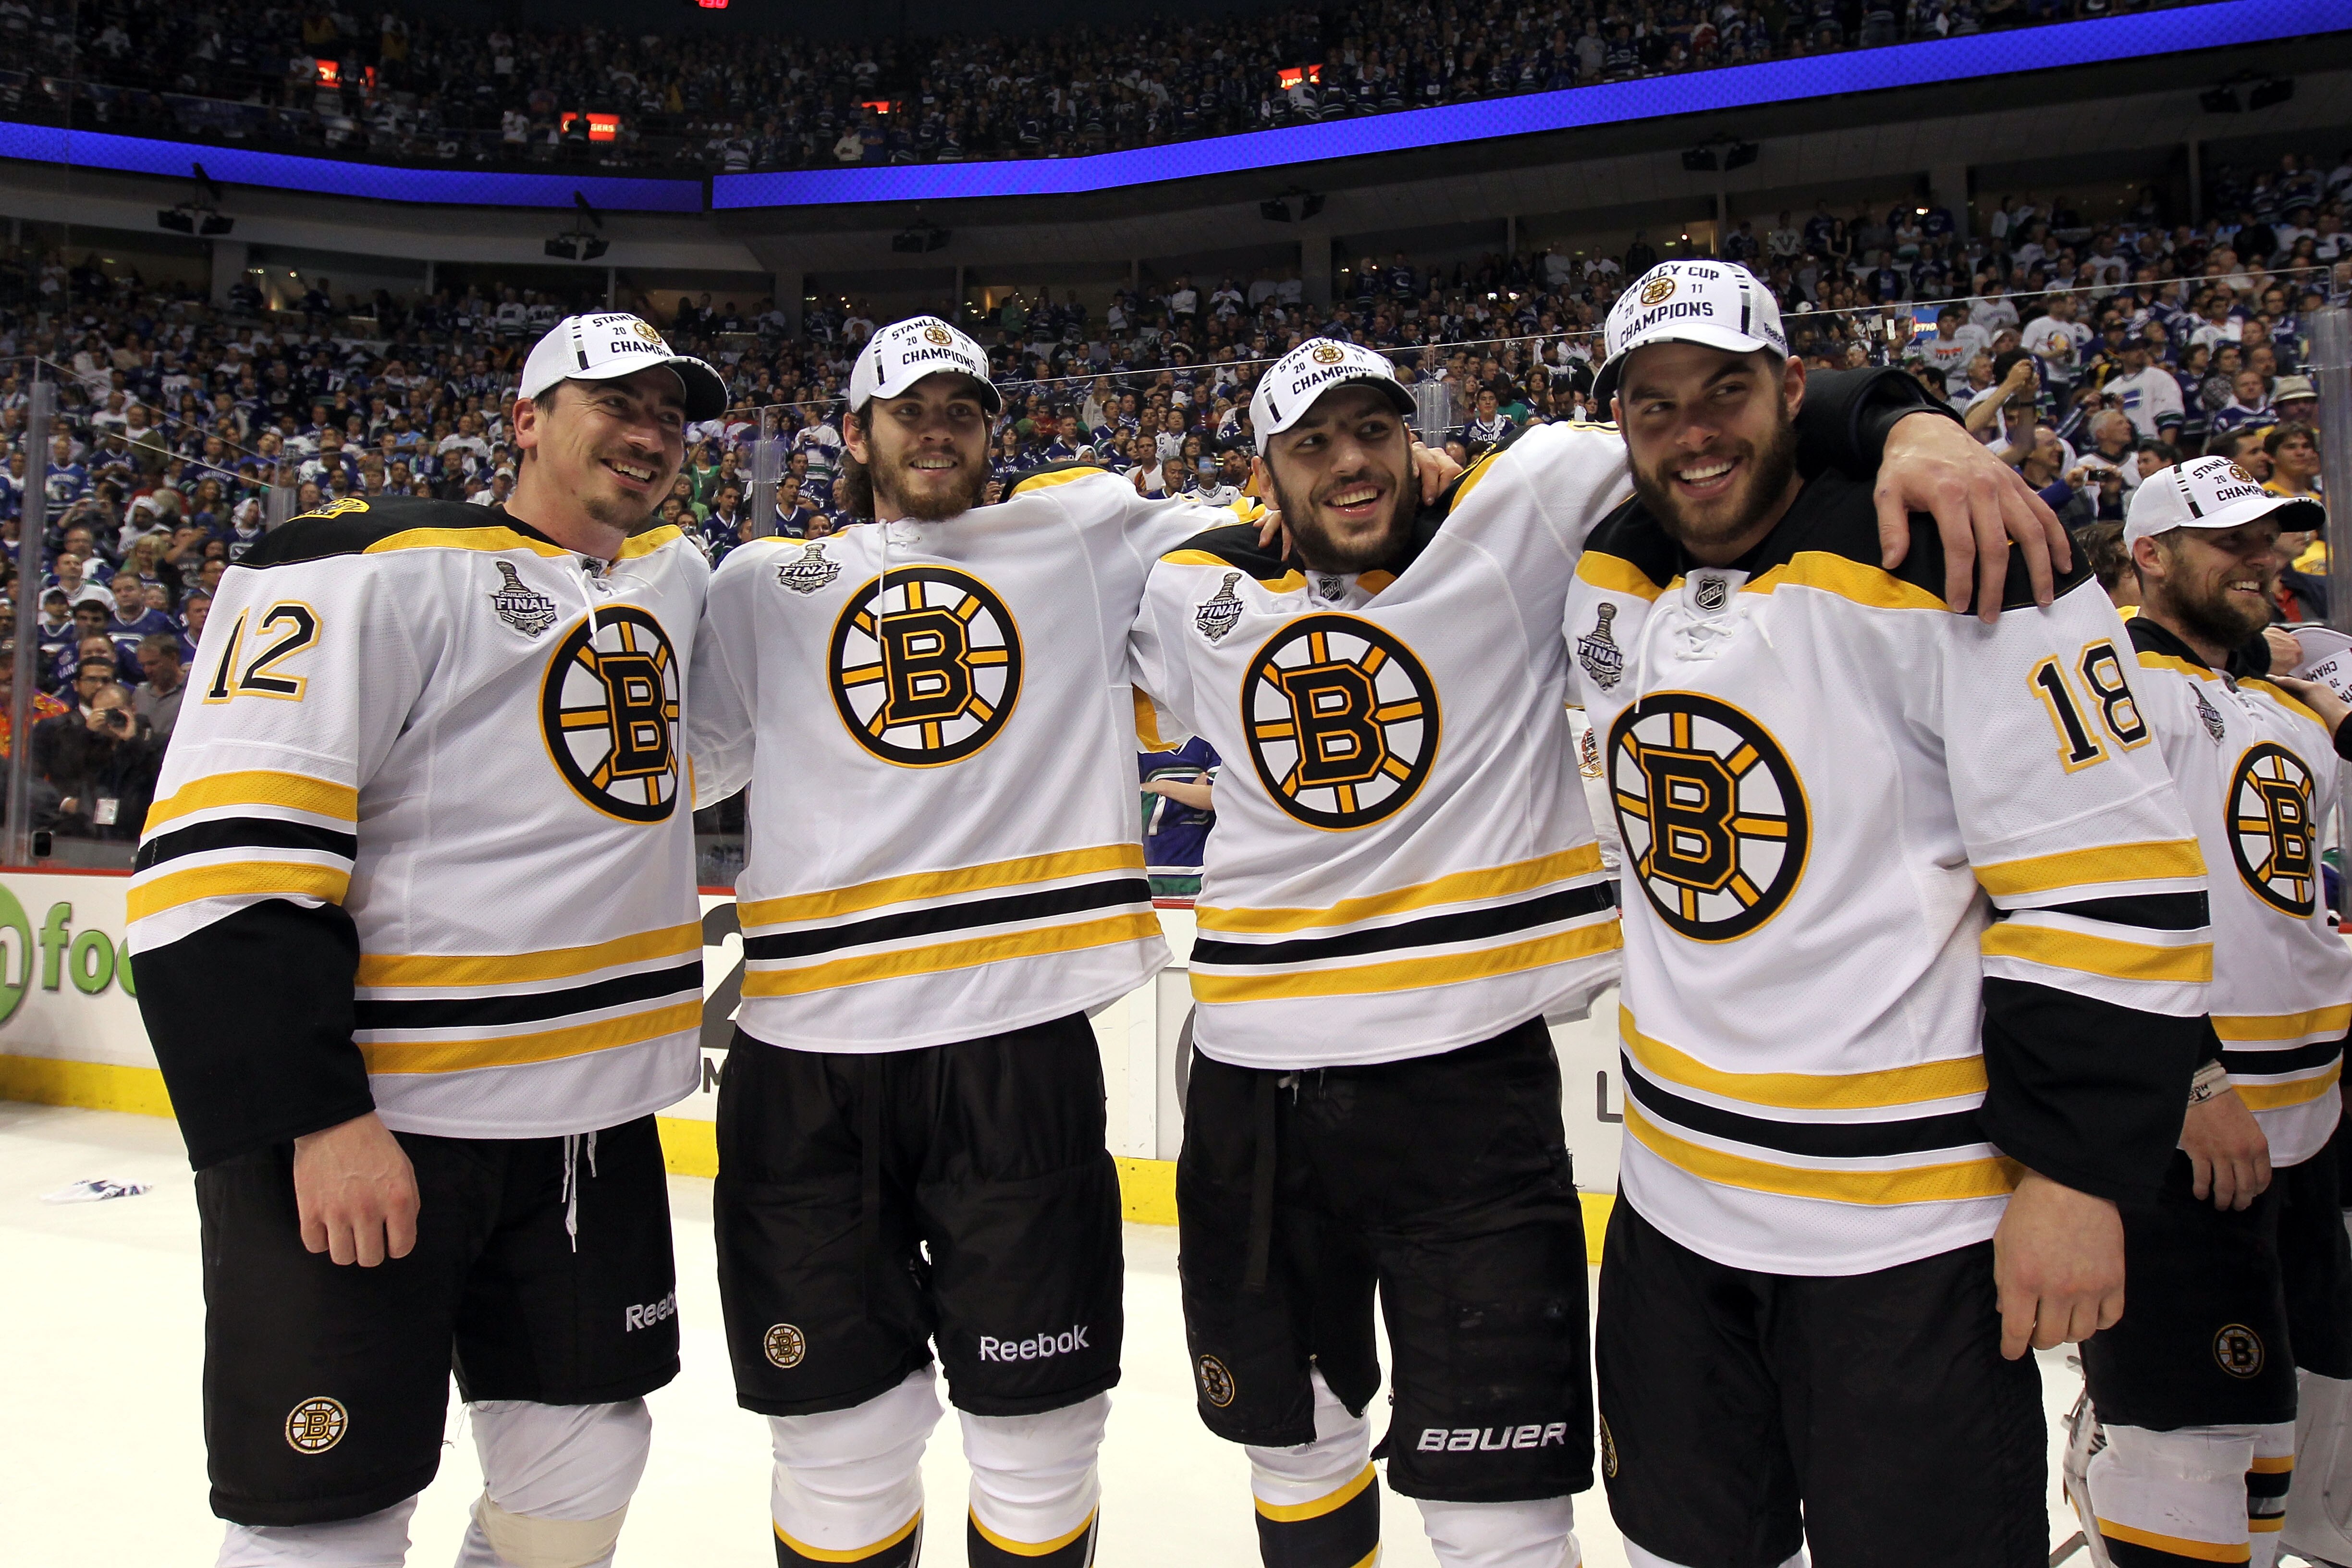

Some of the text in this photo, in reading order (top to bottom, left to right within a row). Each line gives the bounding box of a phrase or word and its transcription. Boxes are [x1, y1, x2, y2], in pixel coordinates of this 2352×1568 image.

[590, 123, 615, 132] GERS
[1617, 265, 1720, 315] STANLEY CUP
[1625, 284, 1703, 319] 20 11
[592, 315, 642, 327] STANL
[892, 318, 948, 340] STANLEY
[1620, 301, 1714, 347] CHAMPIONS
[1914, 322, 1938, 333] CTIO
[612, 327, 626, 335] 20
[906, 336, 968, 353] 20 11
[902, 348, 977, 372] CHAMPIONS
[1279, 337, 1336, 373] STANLEY
[1294, 362, 1306, 374] 20
[2193, 459, 2231, 479] STANL
[2214, 475, 2227, 484] 20
[2216, 485, 2264, 502] CHAMP
[781, 564, 843, 576] FINAL
[1324, 583, 1337, 598] NHL
[1701, 586, 1722, 603] NHL
[496, 597, 553, 610] FINAL
[1198, 603, 1244, 618] FINAL
[202, 599, 323, 705] 12
[1579, 641, 1622, 669] FINAL
[2026, 636, 2153, 775] 18
[626, 1291, 676, 1332] Reeb
[979, 1324, 1090, 1362] Reebok
